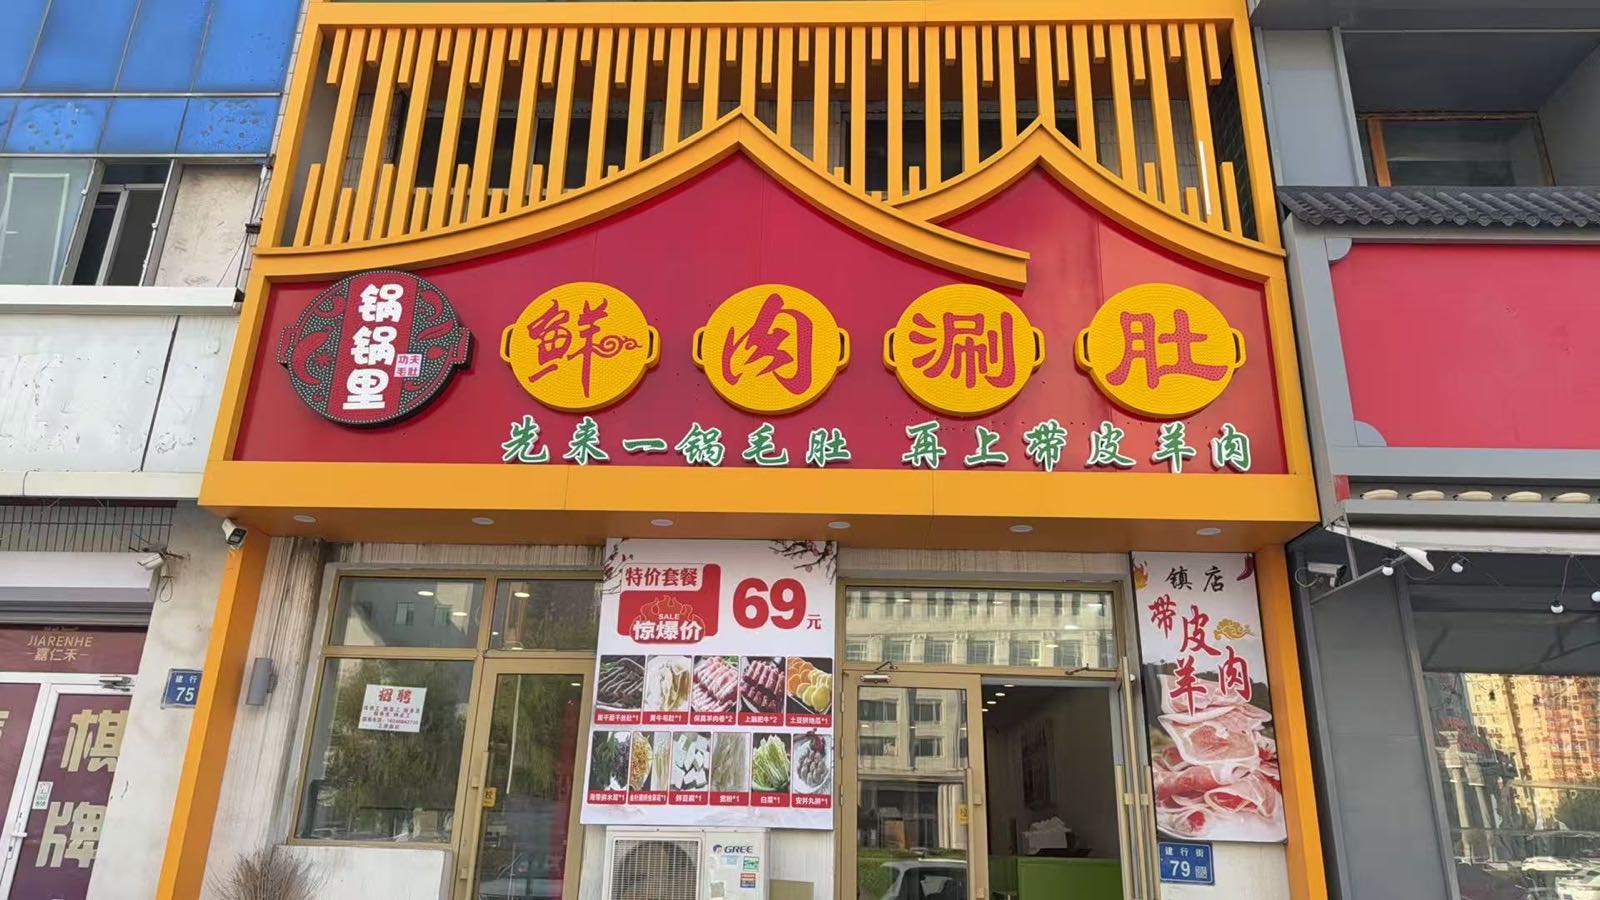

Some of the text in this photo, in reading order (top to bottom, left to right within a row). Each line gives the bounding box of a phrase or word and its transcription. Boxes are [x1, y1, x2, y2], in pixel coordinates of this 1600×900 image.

[341, 283, 404, 411] 锅锅里
[527, 293, 1228, 398] 鲜肉涮肚
[501, 414, 1252, 474] 先来一锅毛肚 再上带皮羊肉
[624, 567, 698, 588] 特价套餐
[1164, 565, 1226, 593] 镇店
[658, 613, 681, 621] SALE
[633, 620, 703, 642] 惊爆价
[27, 634, 94, 648] JIARENHE
[34, 648, 78, 662] 嘉仁禾
[176, 687, 195, 702] 75
[724, 845, 753, 854] GREE
[1169, 860, 1191, 877] 79
